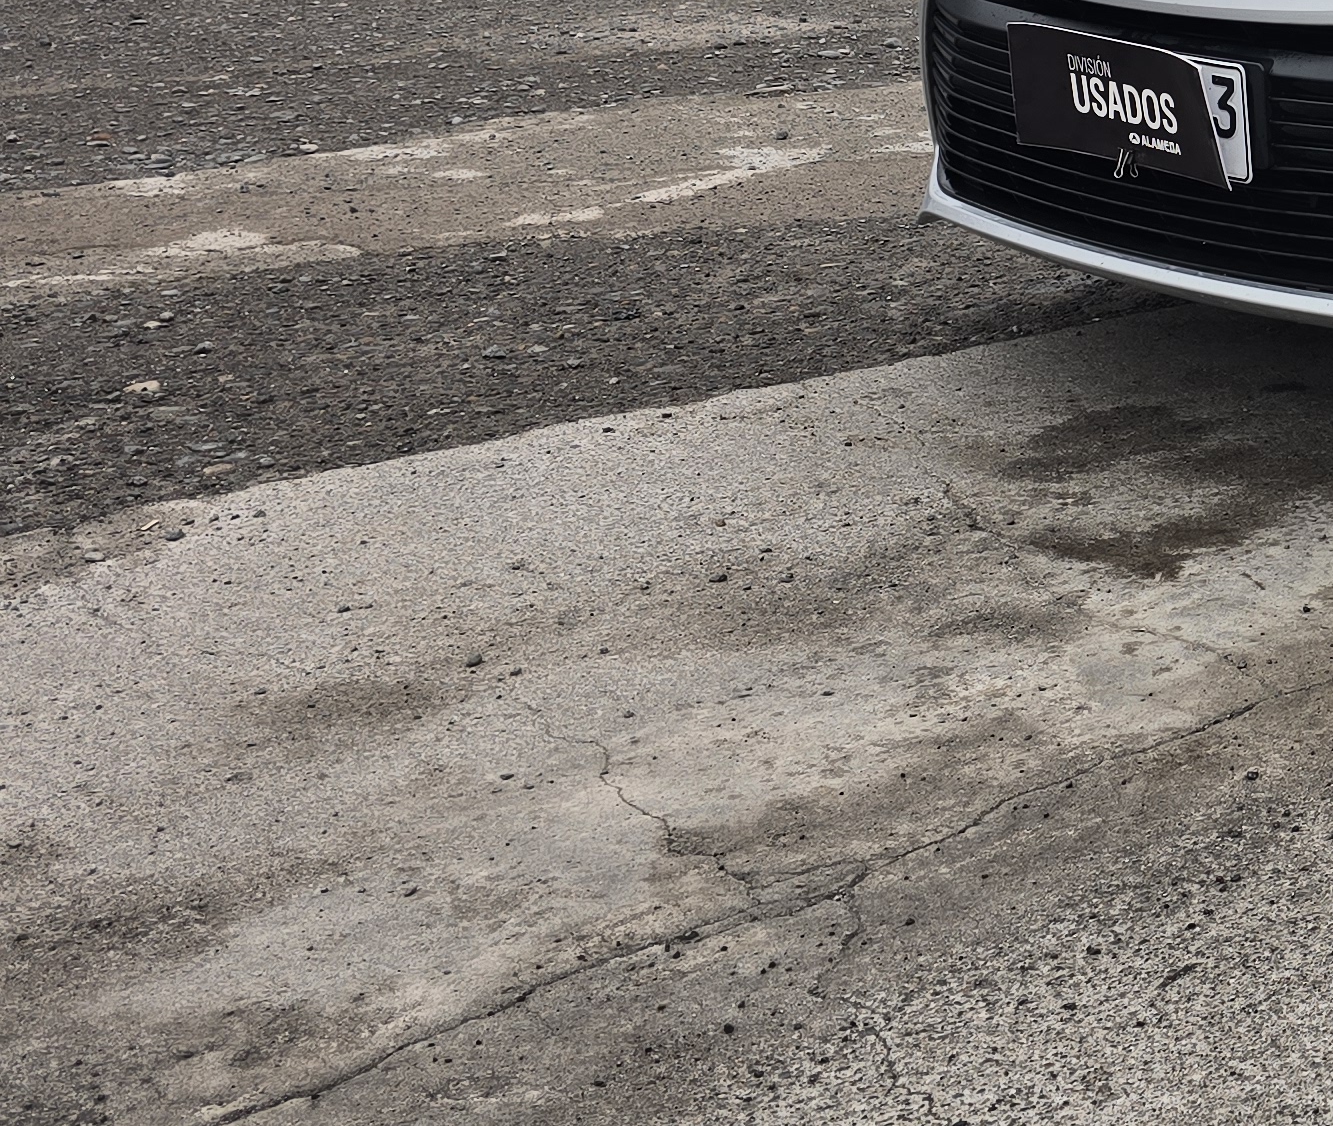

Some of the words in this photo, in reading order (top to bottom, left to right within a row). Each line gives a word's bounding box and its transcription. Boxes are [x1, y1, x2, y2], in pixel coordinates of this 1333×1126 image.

[1067, 53, 1112, 78] DIVISIÓN
[1070, 72, 1178, 134] USADOS
[1211, 74, 1237, 139] 3
[1141, 134, 1182, 156] ALAMEDA
